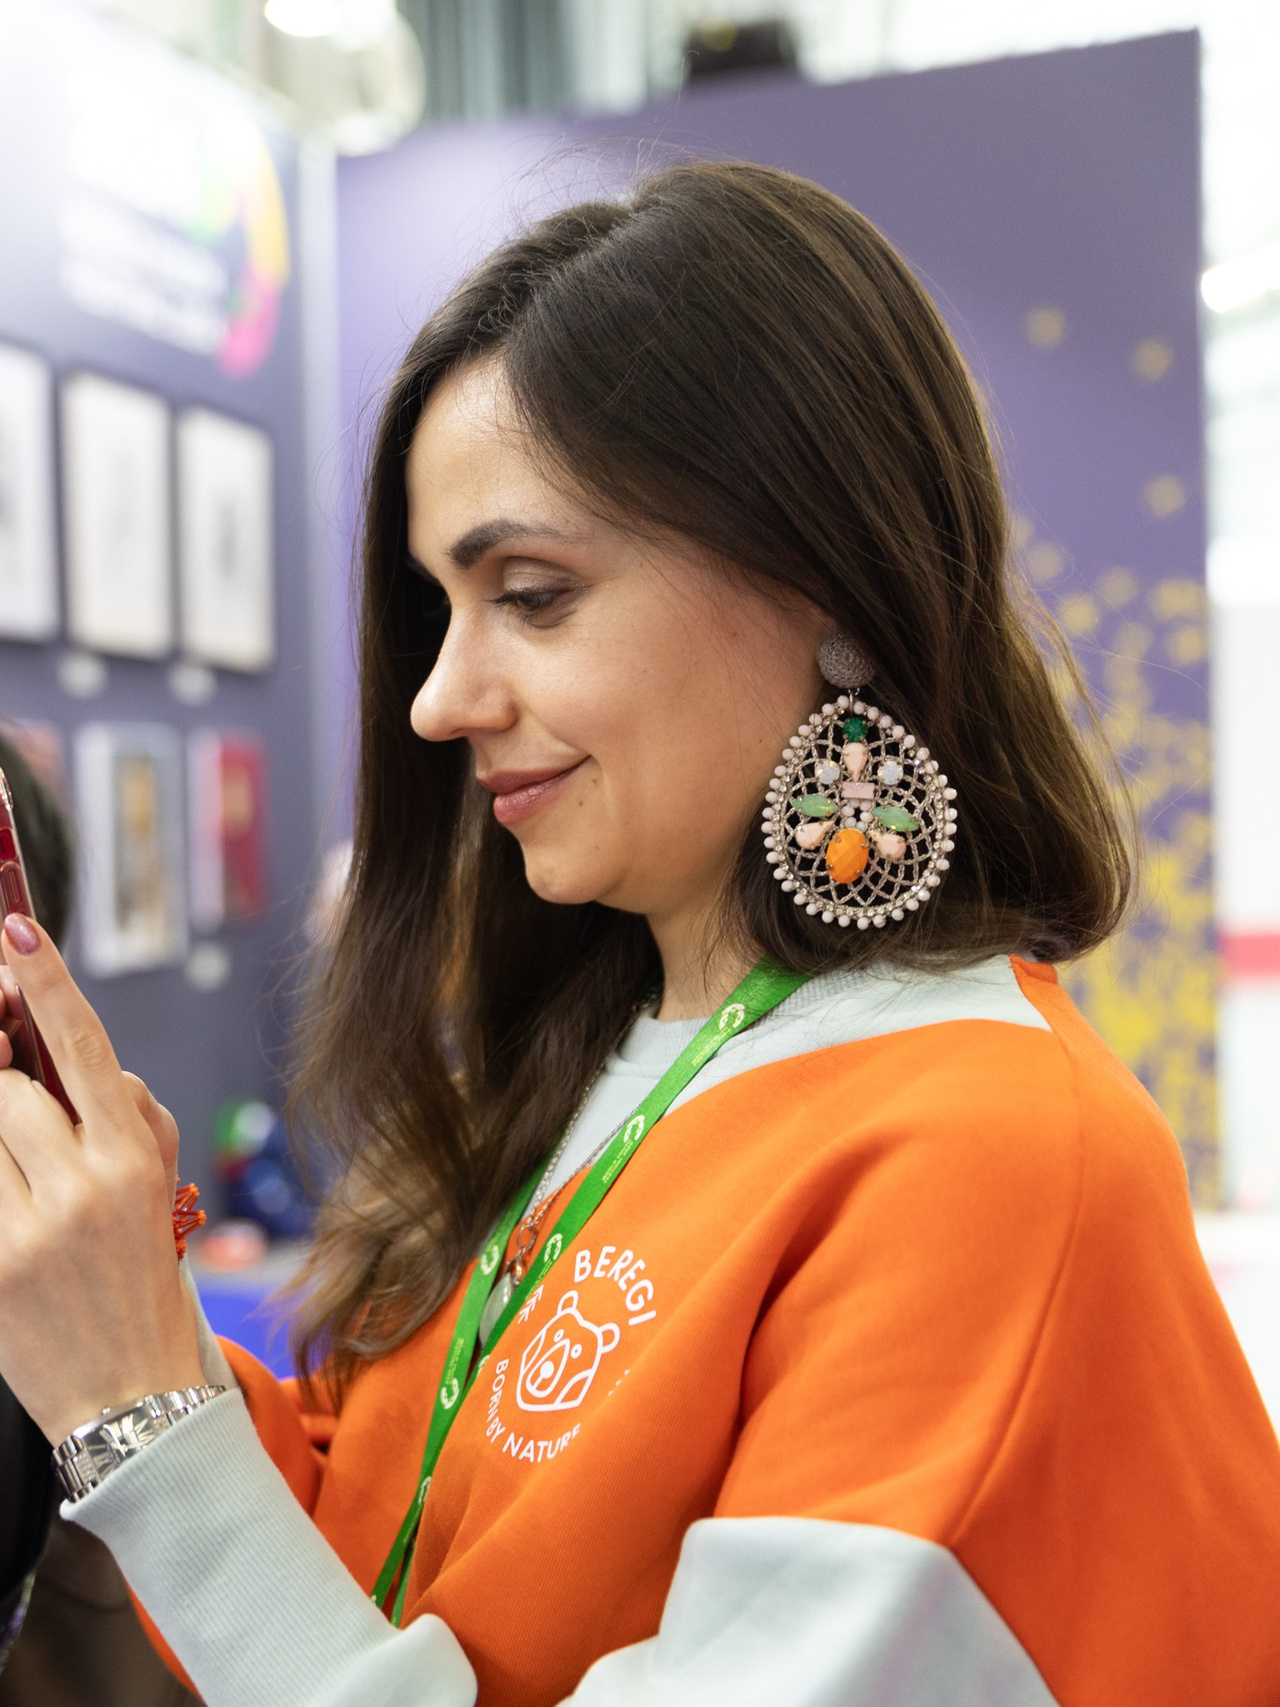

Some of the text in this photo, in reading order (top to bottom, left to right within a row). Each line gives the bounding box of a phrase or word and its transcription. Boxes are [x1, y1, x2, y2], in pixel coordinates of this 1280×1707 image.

[574, 1245, 657, 1326] BEREGI
[486, 1358, 510, 1423] BORN
[486, 1416, 506, 1444] BY
